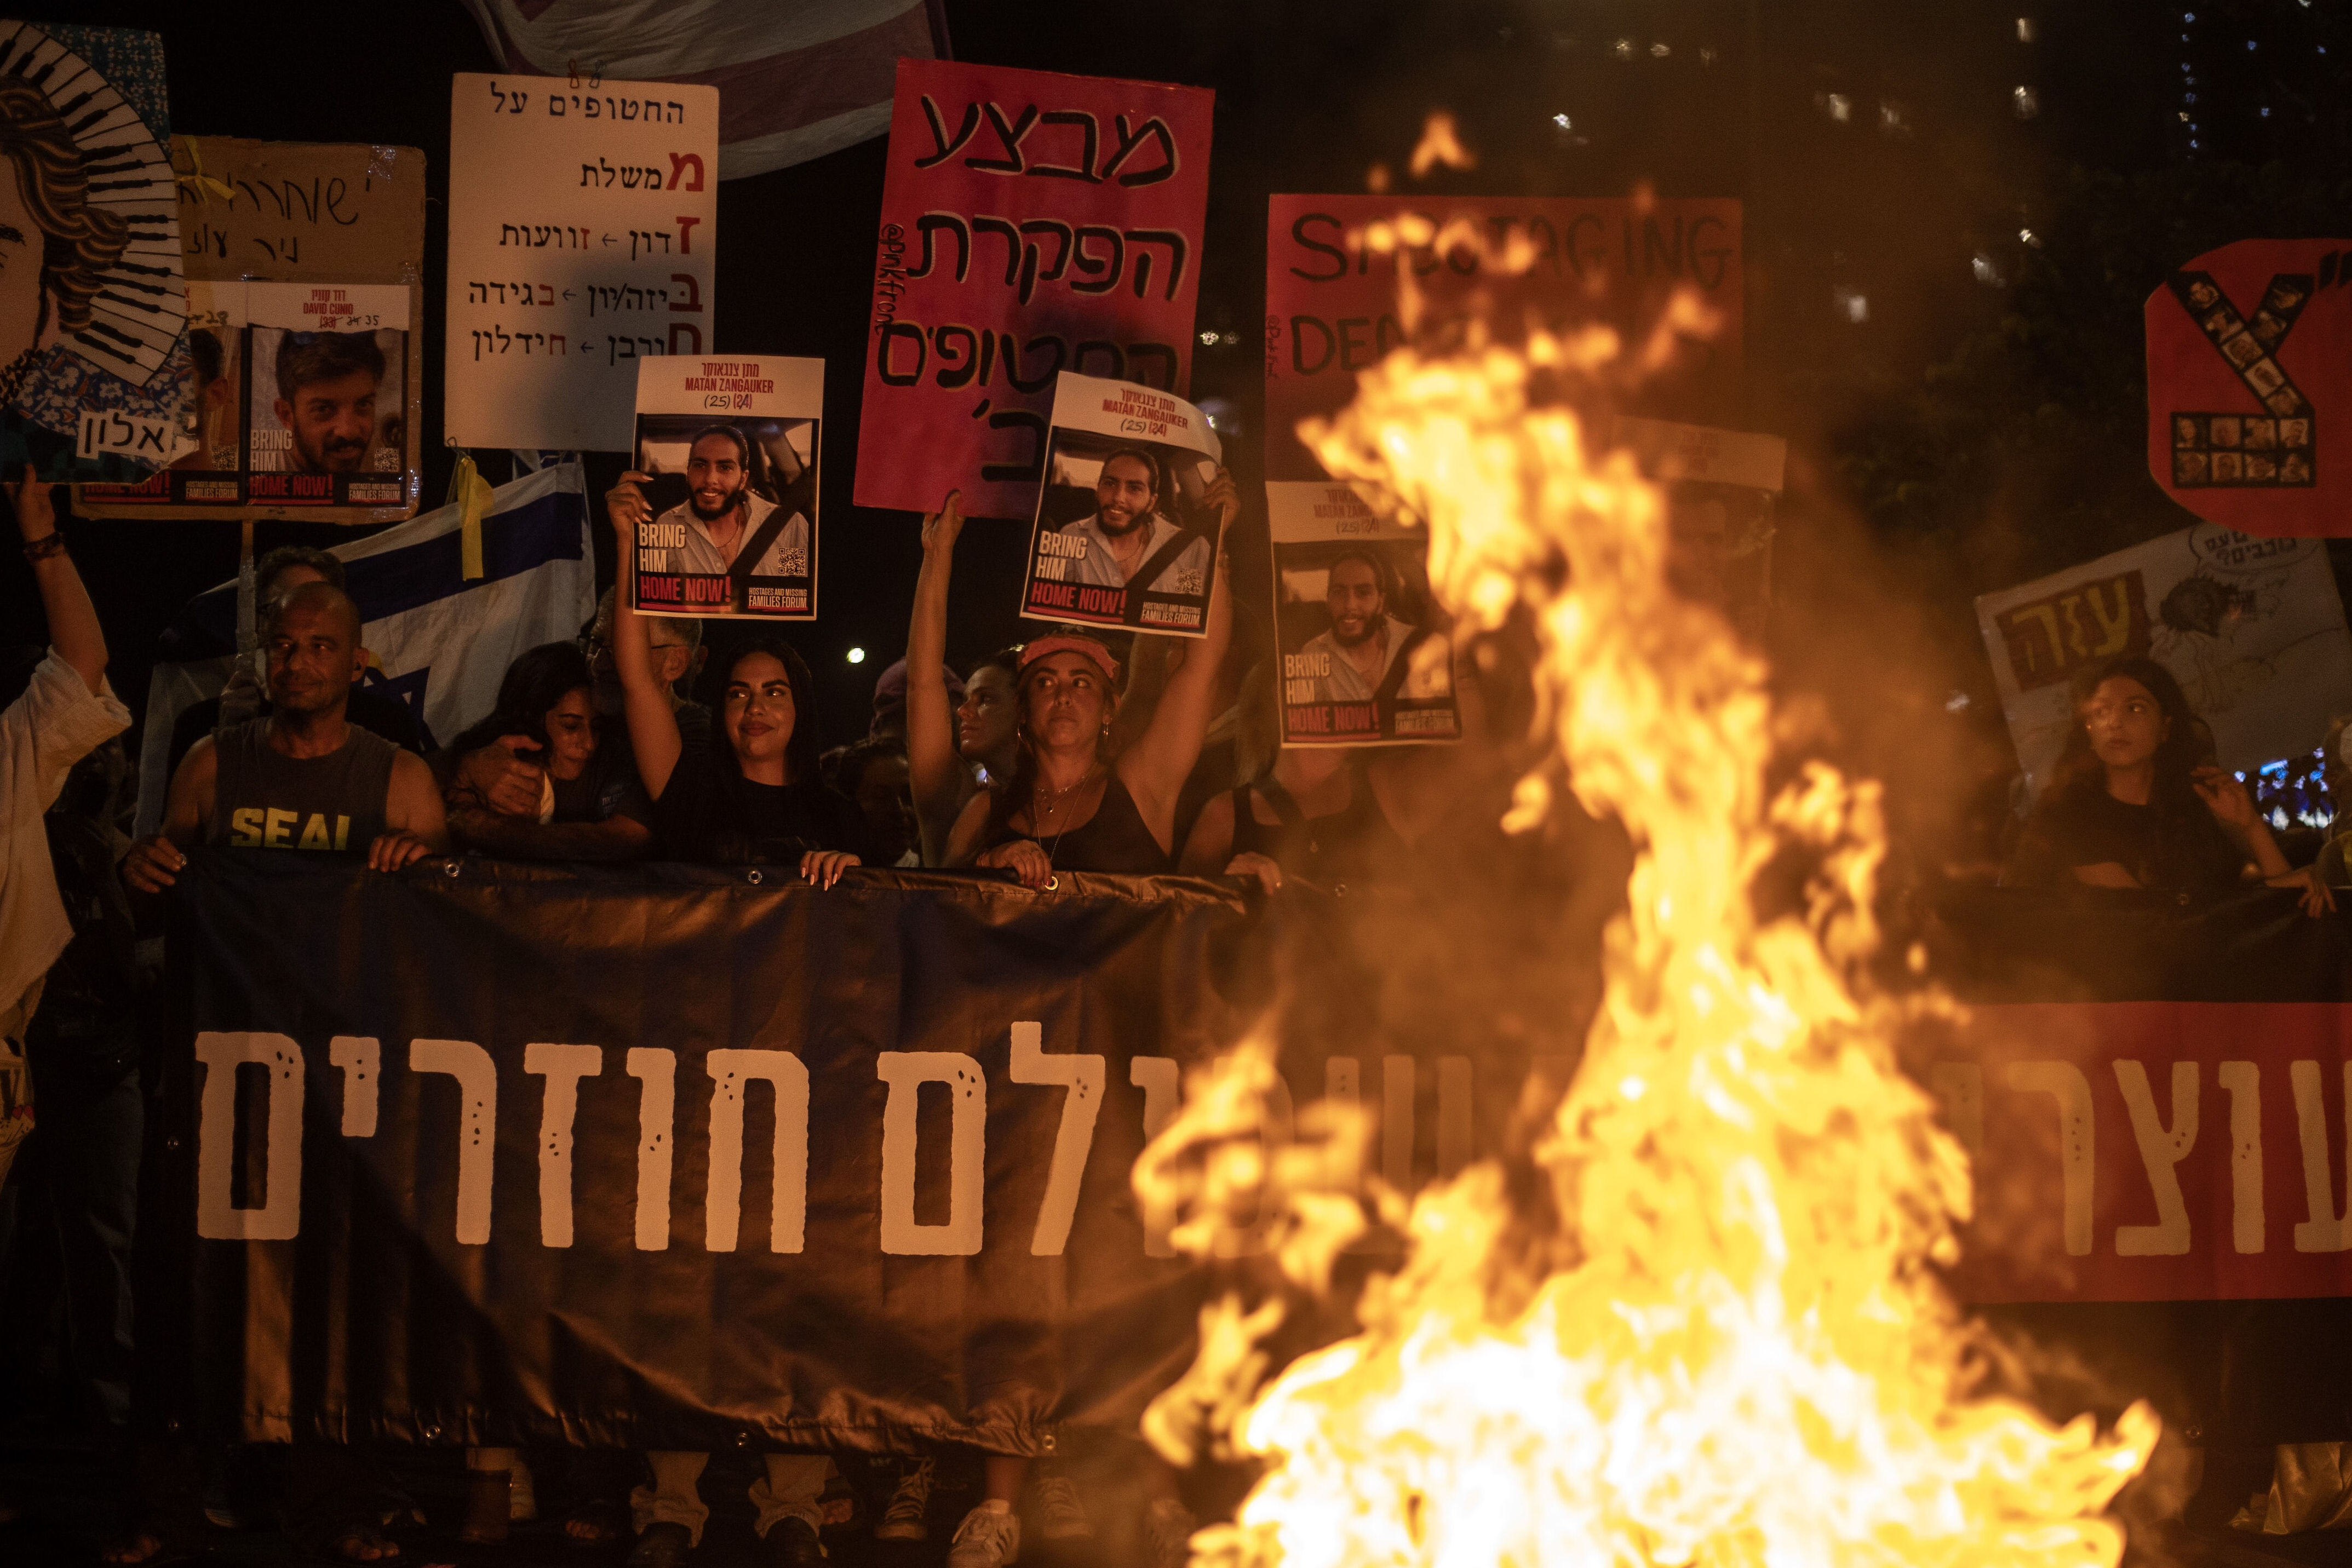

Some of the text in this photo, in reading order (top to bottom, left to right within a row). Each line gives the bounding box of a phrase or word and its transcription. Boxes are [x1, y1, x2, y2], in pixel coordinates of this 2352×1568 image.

[490, 81, 684, 124] החטופים על
[914, 92, 1180, 188] מבצע
[580, 152, 704, 192] ממשלת
[253, 236, 298, 263] ניר
[499, 216, 701, 261] זדון זוועות
[907, 210, 1189, 306] הפקרת
[469, 281, 555, 307] בגידה
[303, 302, 354, 315] DAVID CUNIO
[365, 315, 380, 326] 35
[472, 324, 566, 361] חידלון
[701, 362, 760, 378] מתן צנגאוקר
[685, 377, 775, 394] MATAN ZANGAUKER
[704, 394, 731, 410] (25)
[1102, 399, 1189, 429] MATAN ZANGAUKER
[1159, 397, 1175, 412] מתן
[84, 412, 165, 455] אלון
[1121, 418, 1146, 434] (25)
[250, 429, 293, 450] BRING
[250, 450, 277, 472] HIM
[185, 487, 239, 499] FAMILIES FORUM
[249, 473, 334, 497] HOME NOW!
[348, 490, 401, 501] FAMILIES FORUM
[639, 522, 686, 549] BRING
[1038, 530, 1088, 560] BRING
[639, 548, 667, 573] HIM
[1035, 555, 1067, 582] HIM
[640, 575, 732, 603] HOME NOW!
[748, 587, 808, 598] HOSTAGES AND MISSING
[748, 595, 807, 609] FAMILIES FORUM
[1030, 581, 1128, 615] HOME NOW!
[1141, 608, 1201, 625] FAMILIES FORUM
[2011, 576, 2131, 673] עזה
[1284, 653, 1331, 679] BRING
[1287, 705, 1330, 733] HOME
[1334, 700, 1380, 732] NOW!
[194, 1030, 811, 1254] חוזרים
